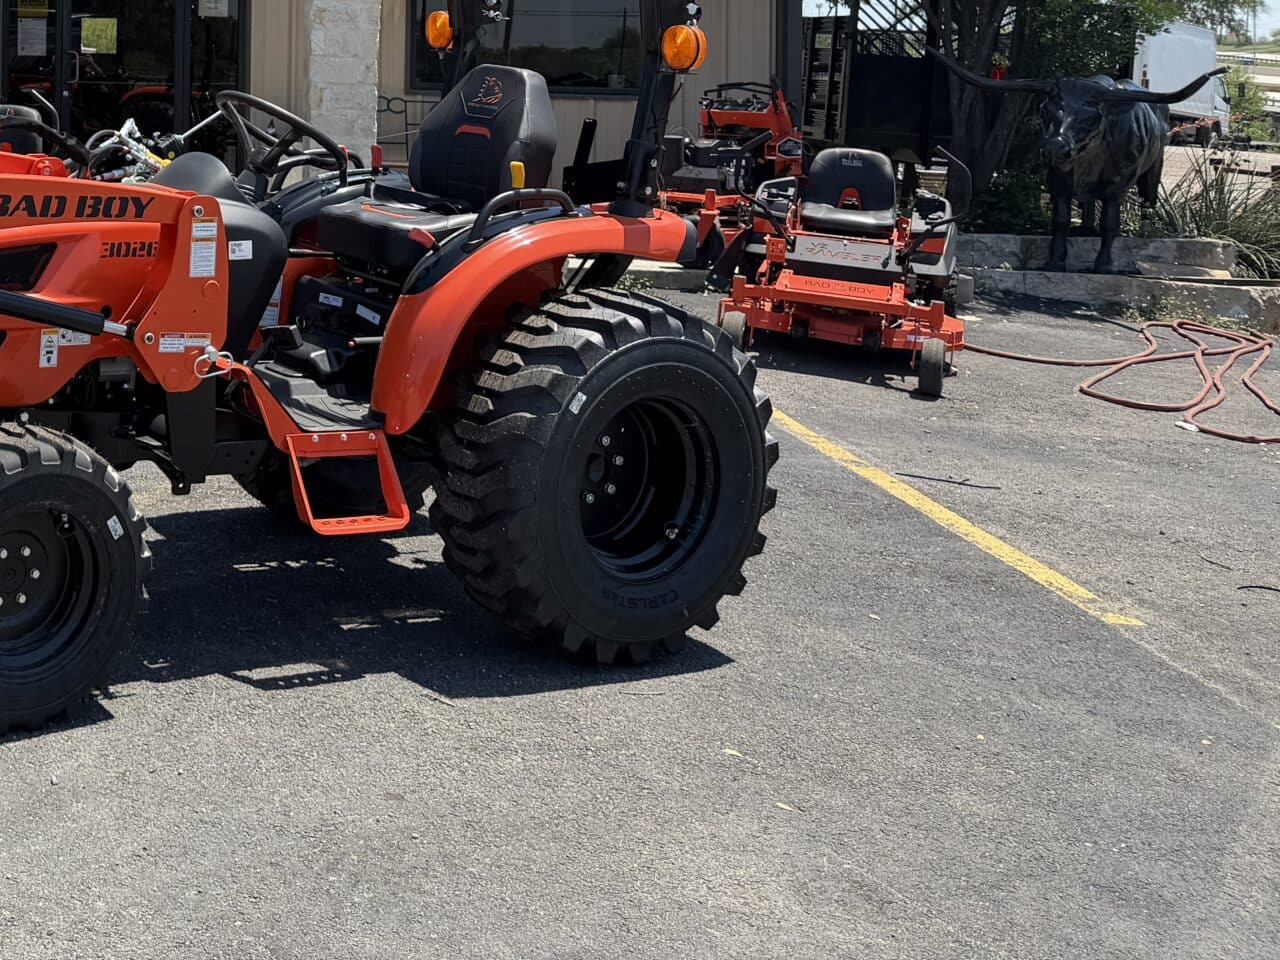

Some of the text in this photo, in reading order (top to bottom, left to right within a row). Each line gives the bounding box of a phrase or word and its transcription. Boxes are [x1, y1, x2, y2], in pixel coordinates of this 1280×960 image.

[74, 194, 157, 219] BOY
[804, 280, 875, 294] BAD BOY
